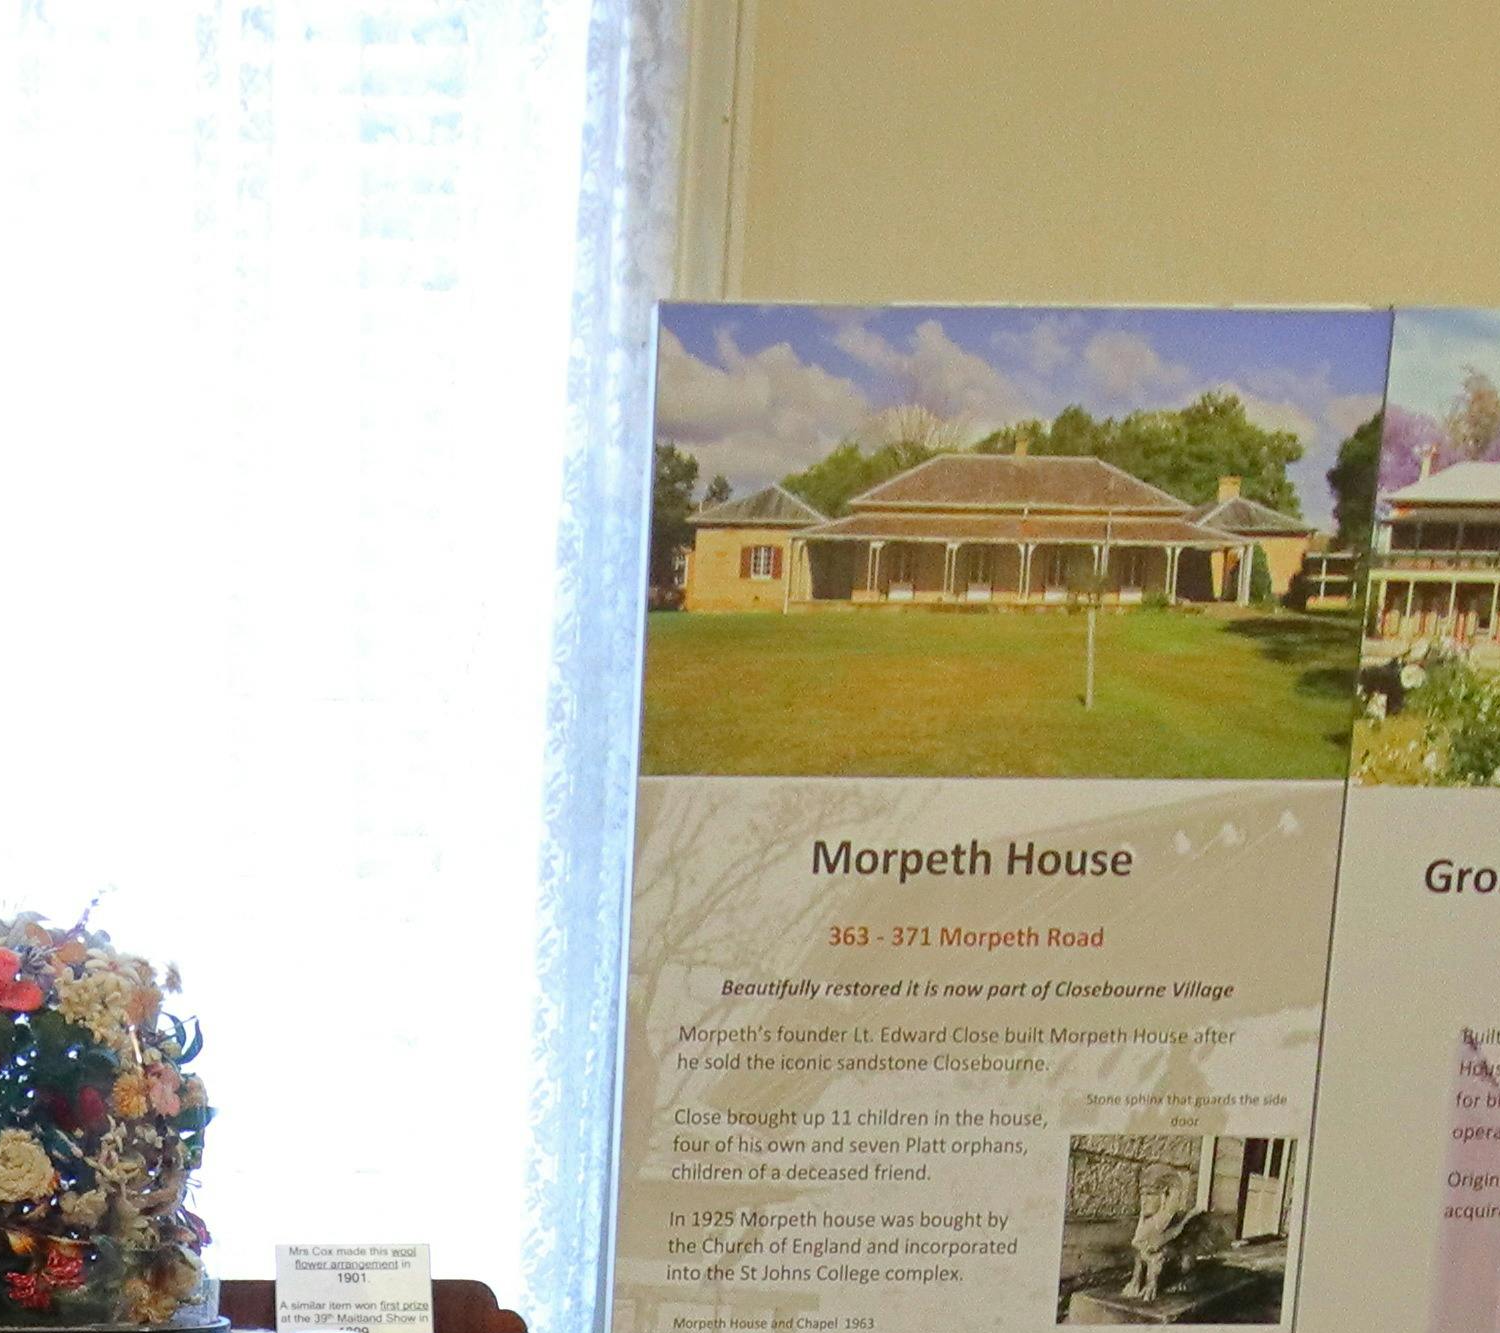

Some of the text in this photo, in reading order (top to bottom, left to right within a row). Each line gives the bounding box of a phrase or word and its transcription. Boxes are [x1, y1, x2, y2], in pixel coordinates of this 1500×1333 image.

[812, 840, 1132, 884] Morpeth House
[829, 926, 868, 946] 363
[892, 926, 930, 946] 371
[940, 926, 1038, 951] Morpeth
[1048, 927, 1104, 947] Road
[721, 978, 1234, 1001] Beautifully restored it is now part of Closebourne Village
[670, 1210, 1008, 1232] In 1925 Morpeth house was bought by
[289, 1246, 416, 1257] Mrs Cox made this wool
[295, 1260, 411, 1271] flower arrangement in
[337, 1272, 370, 1283] 1901.
[280, 1302, 288, 1310] A
[291, 1301, 326, 1310] similar
[329, 1302, 351, 1310] item
[380, 1301, 400, 1311] first
[403, 1302, 429, 1311] prize
[281, 1314, 290, 1322] at
[294, 1314, 310, 1322] the
[337, 1314, 382, 1323] Maitland
[386, 1314, 415, 1323] Show
[419, 1314, 428, 1323] in
